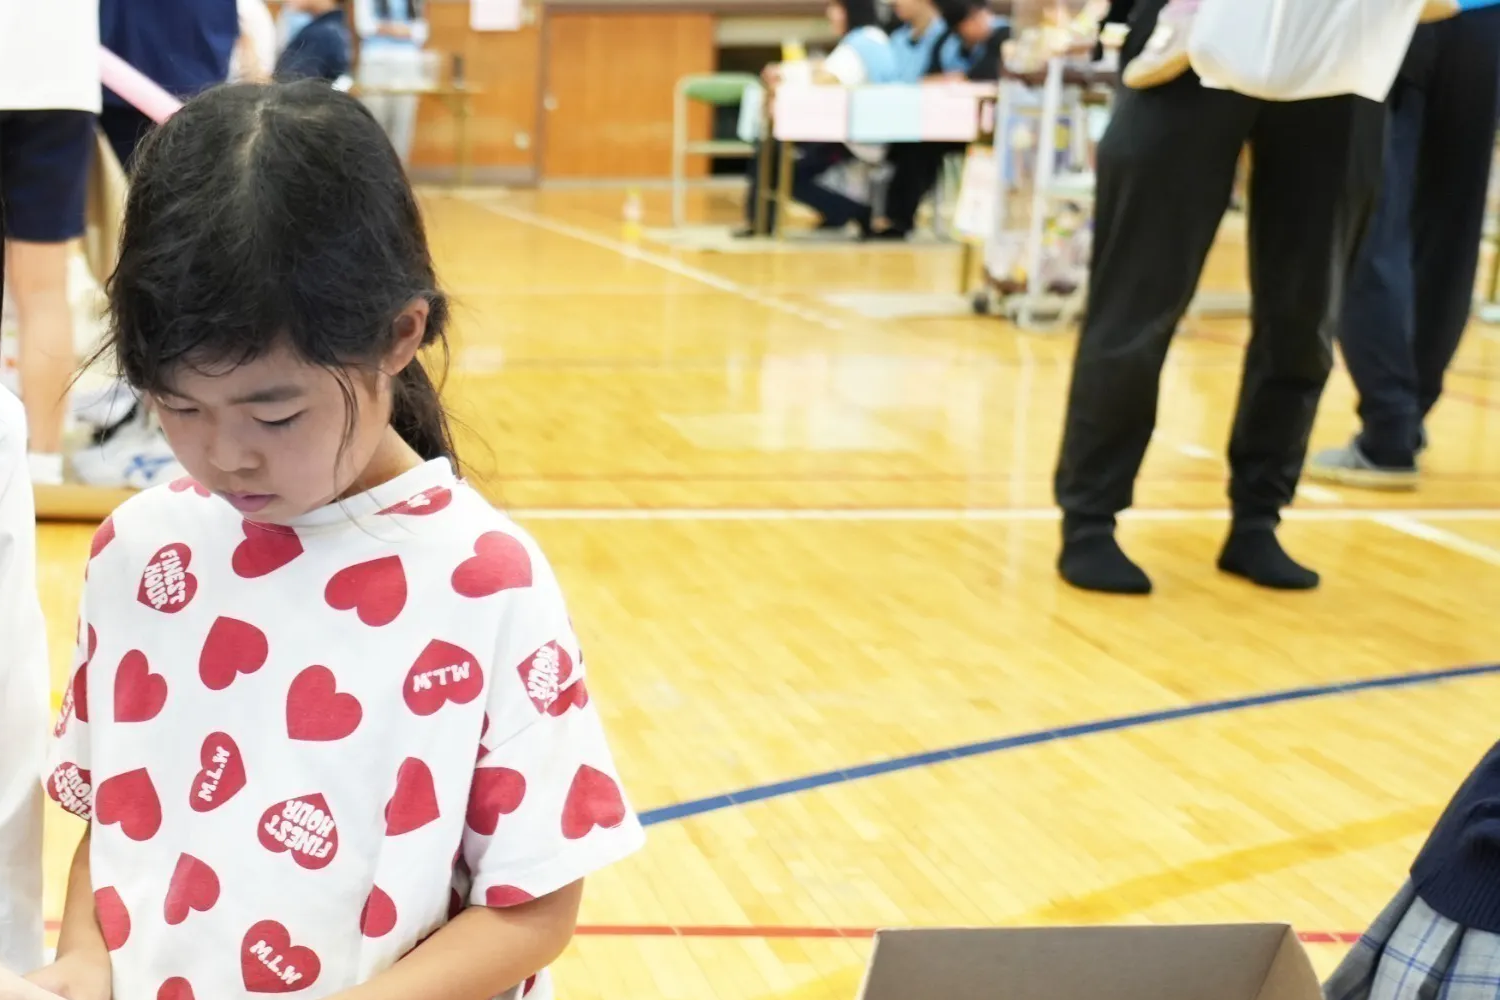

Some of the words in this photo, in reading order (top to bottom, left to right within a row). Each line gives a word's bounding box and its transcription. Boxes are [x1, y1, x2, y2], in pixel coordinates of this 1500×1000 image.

[144, 562, 168, 609] HOUR
[160, 549, 186, 604] FINEST
[198, 746, 230, 802] M.L.W
[264, 815, 334, 858] FINEST
[282, 800, 336, 837] HOUR
[249, 940, 303, 985] M.L.W
